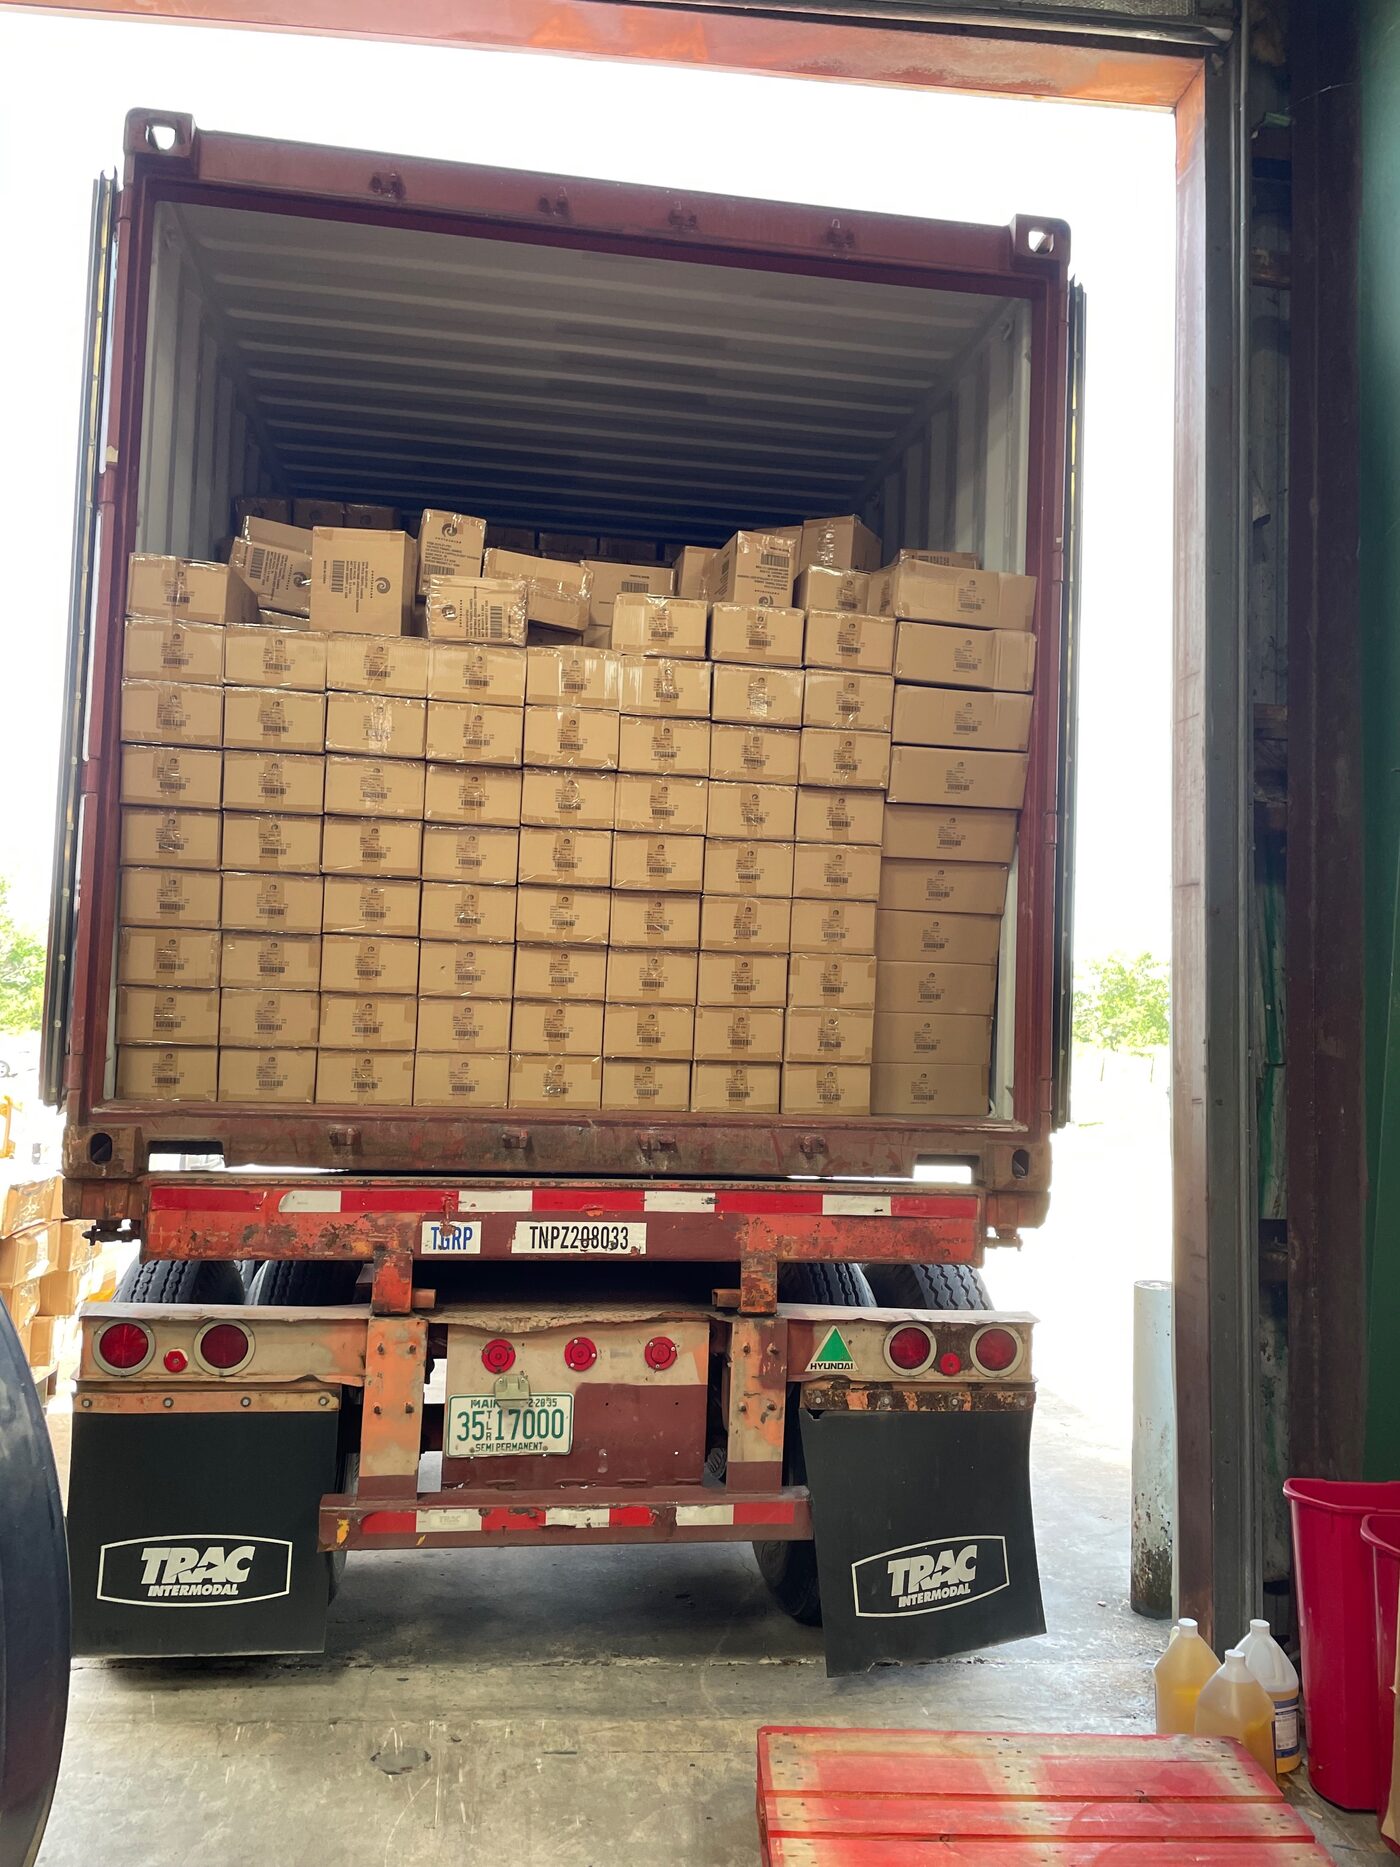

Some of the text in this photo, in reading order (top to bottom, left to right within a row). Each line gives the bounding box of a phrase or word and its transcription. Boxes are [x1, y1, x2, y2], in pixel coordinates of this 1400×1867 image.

[530, 1225, 629, 1250] TNPZ208033
[810, 1362, 854, 1370] HYUNDAI
[457, 1411, 485, 1441] 35
[495, 1408, 564, 1440] 17000
[475, 1441, 543, 1452] SEMI PERMANENT
[141, 1546, 255, 1584] TRAC
[887, 1545, 978, 1597] TRAC
[147, 1584, 239, 1597] INTERMODAL
[898, 1582, 971, 1608] INTERMODAL
